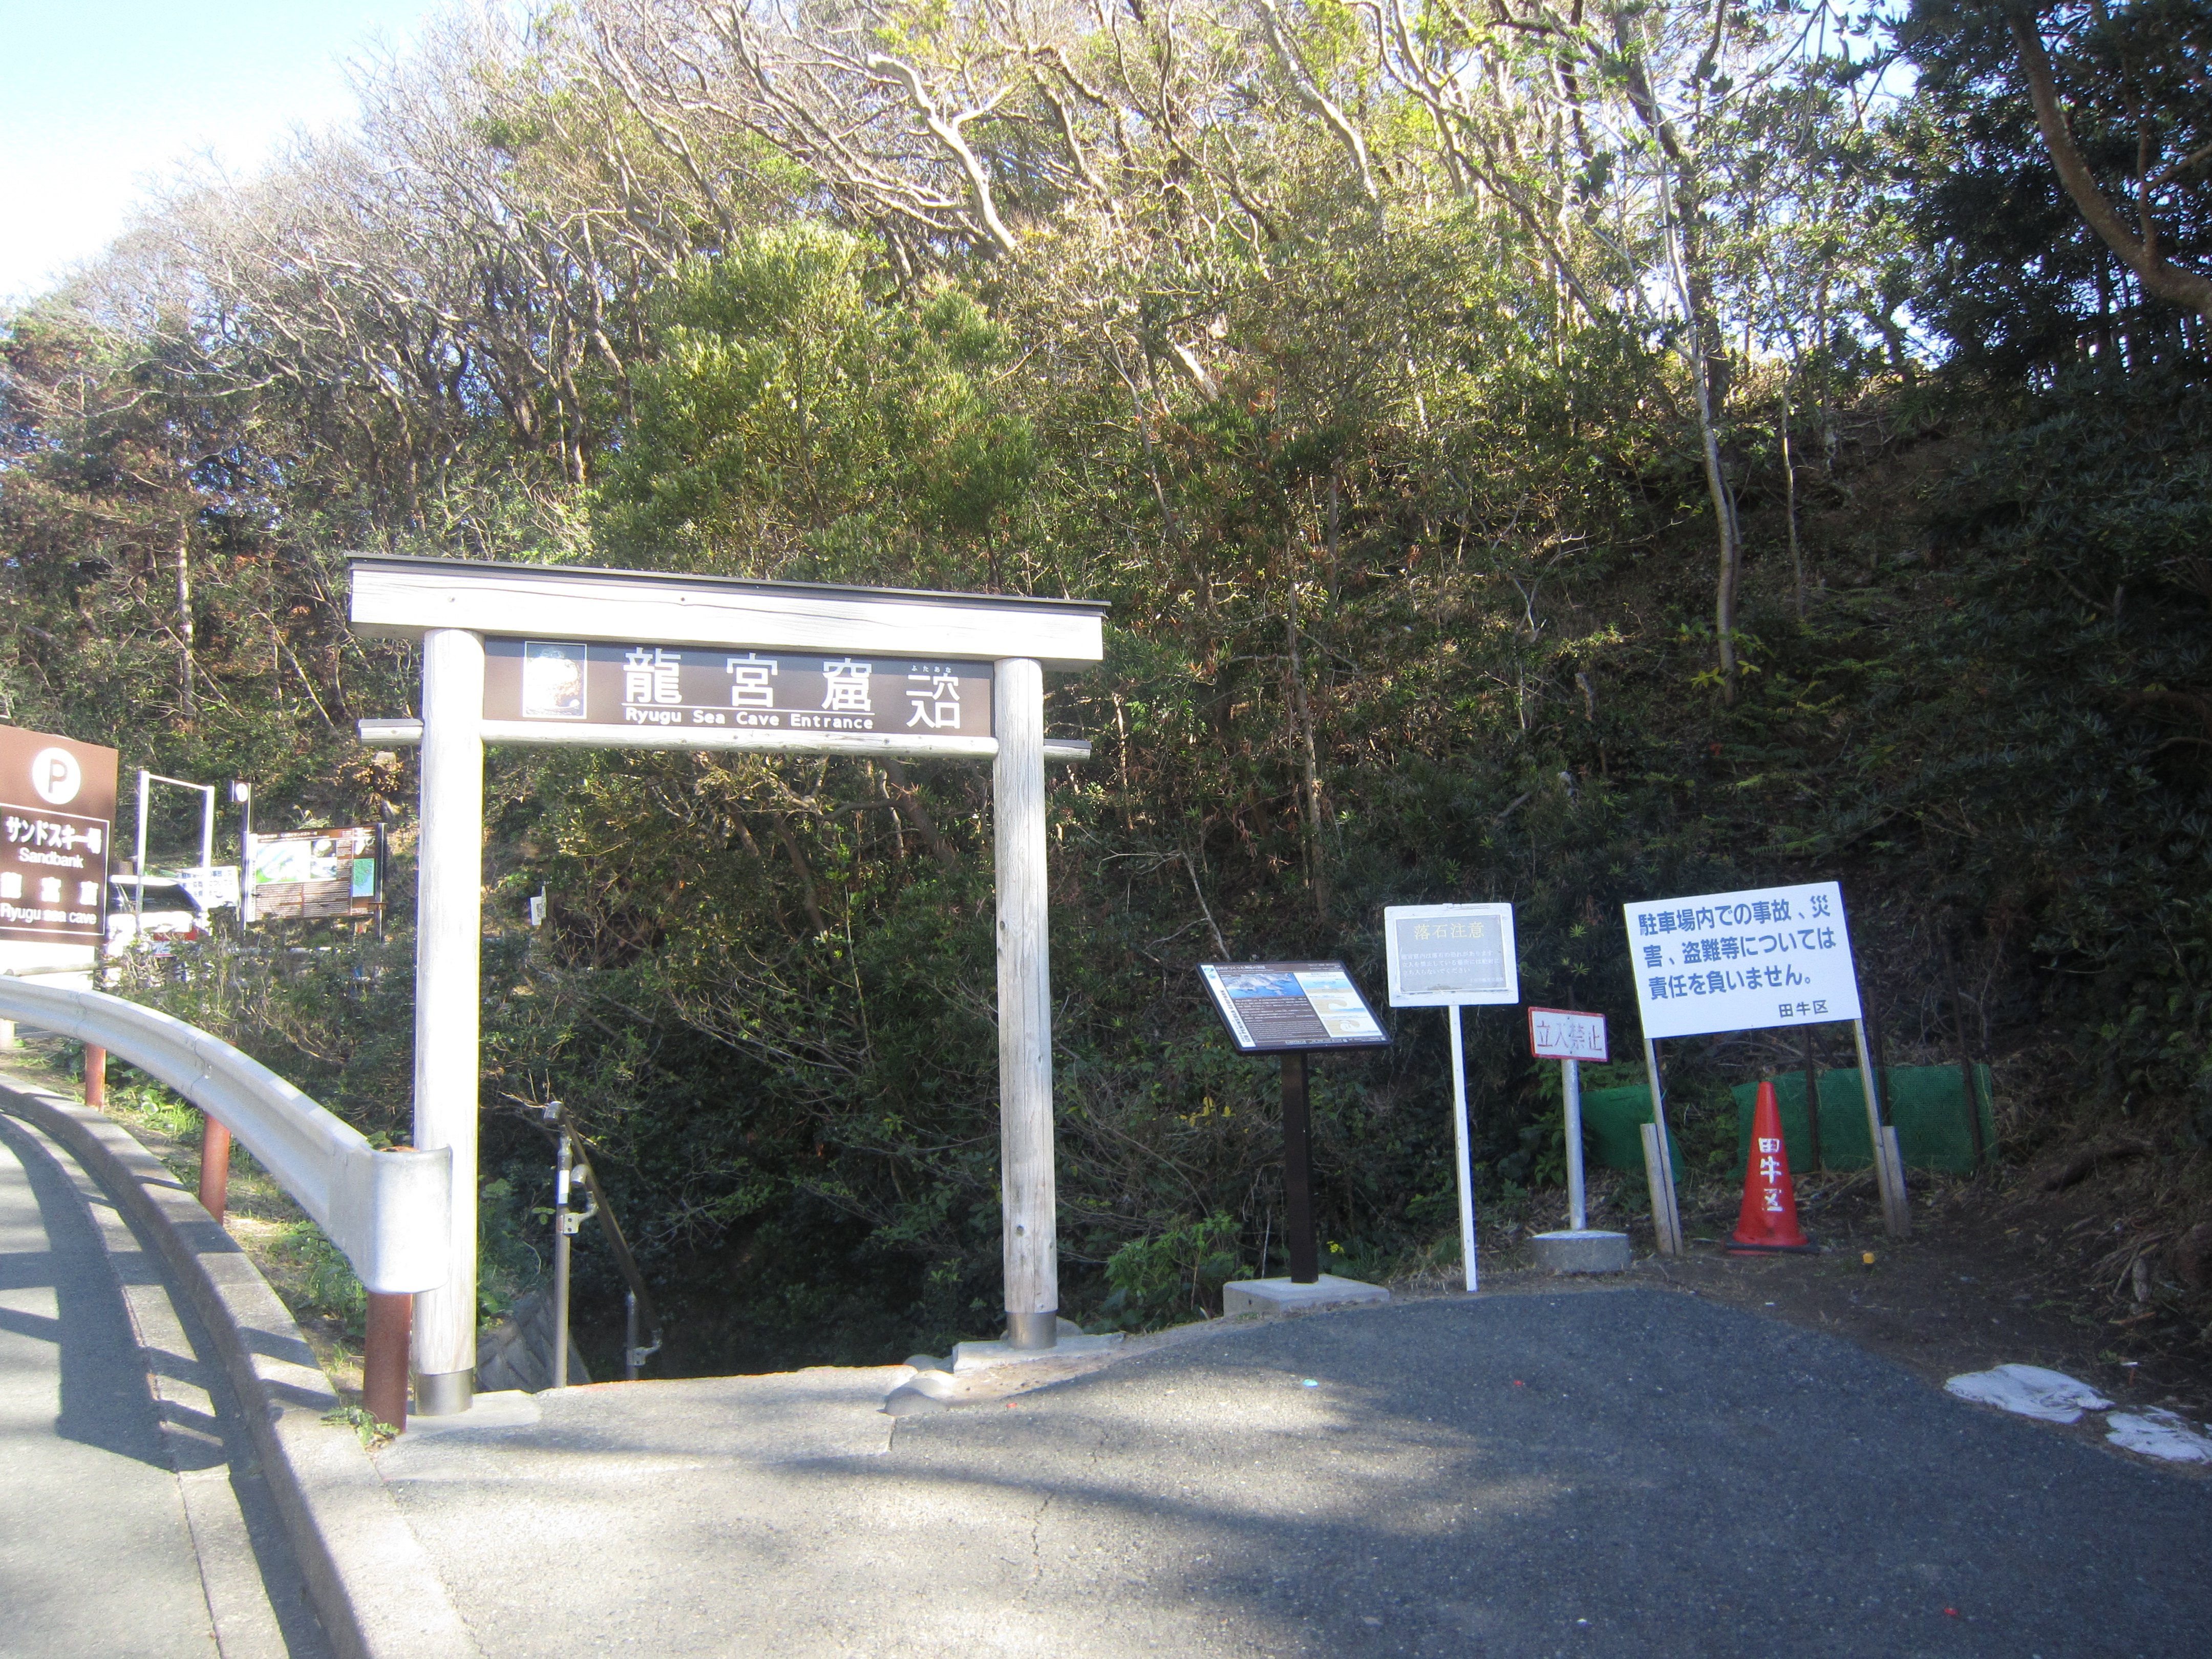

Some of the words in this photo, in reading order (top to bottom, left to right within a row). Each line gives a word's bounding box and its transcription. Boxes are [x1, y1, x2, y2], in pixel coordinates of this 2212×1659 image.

[623, 647, 872, 711] 龍宮窟
[911, 665, 952, 673] ふたあな
[626, 707, 682, 725] Ryugu
[693, 710, 726, 725] Sea
[736, 712, 779, 727] Cave
[791, 713, 874, 729] Entrance
[906, 700, 960, 729] 入口
[48, 758, 68, 794] P
[19, 847, 83, 868] Sandbank
[0, 902, 41, 923] Ryugu
[70, 912, 97, 924] cave
[1638, 895, 1831, 937] 駐車場内での事故、災
[1414, 921, 1484, 941] 落石注意
[1643, 927, 1837, 968] 害、盗難等については
[1648, 964, 1812, 1001] 責任を負いません。
[1778, 999, 1828, 1018] 田牛区
[1537, 1020, 1602, 1051] 立入禁止
